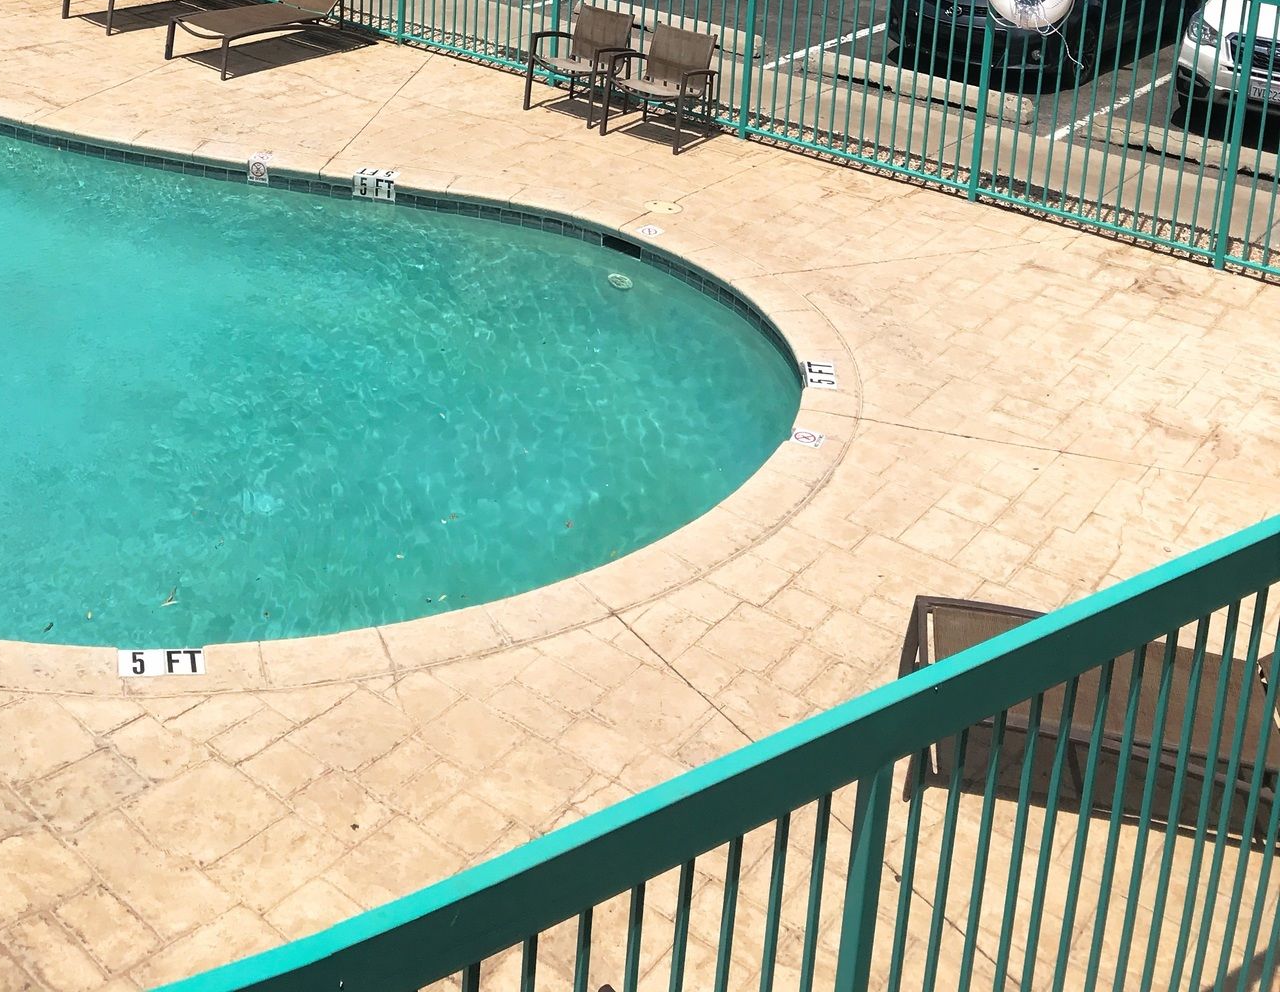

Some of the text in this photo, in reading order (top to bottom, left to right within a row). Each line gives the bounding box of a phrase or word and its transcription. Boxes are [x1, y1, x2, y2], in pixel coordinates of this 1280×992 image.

[360, 177, 394, 198] 5 FT
[807, 361, 834, 375] FT
[132, 650, 201, 674] 5 FT
